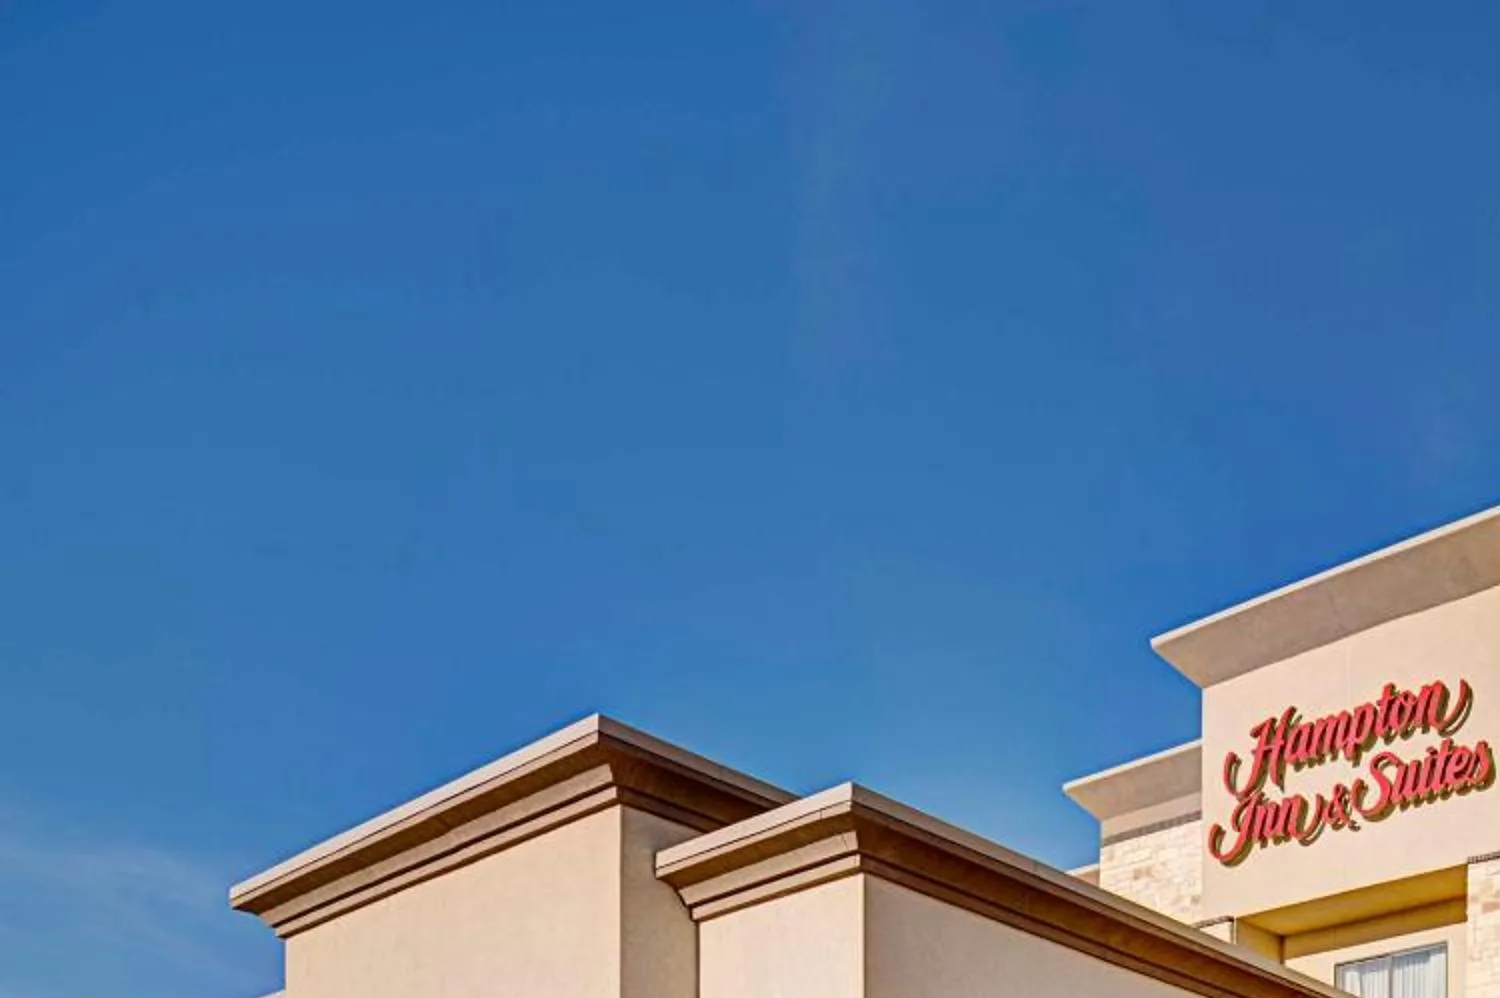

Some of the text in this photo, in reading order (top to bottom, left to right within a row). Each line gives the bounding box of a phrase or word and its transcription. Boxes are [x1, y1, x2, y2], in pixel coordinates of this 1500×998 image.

[1224, 679, 1472, 797] Hampton
[1208, 738, 1495, 865] Inn & Suites
